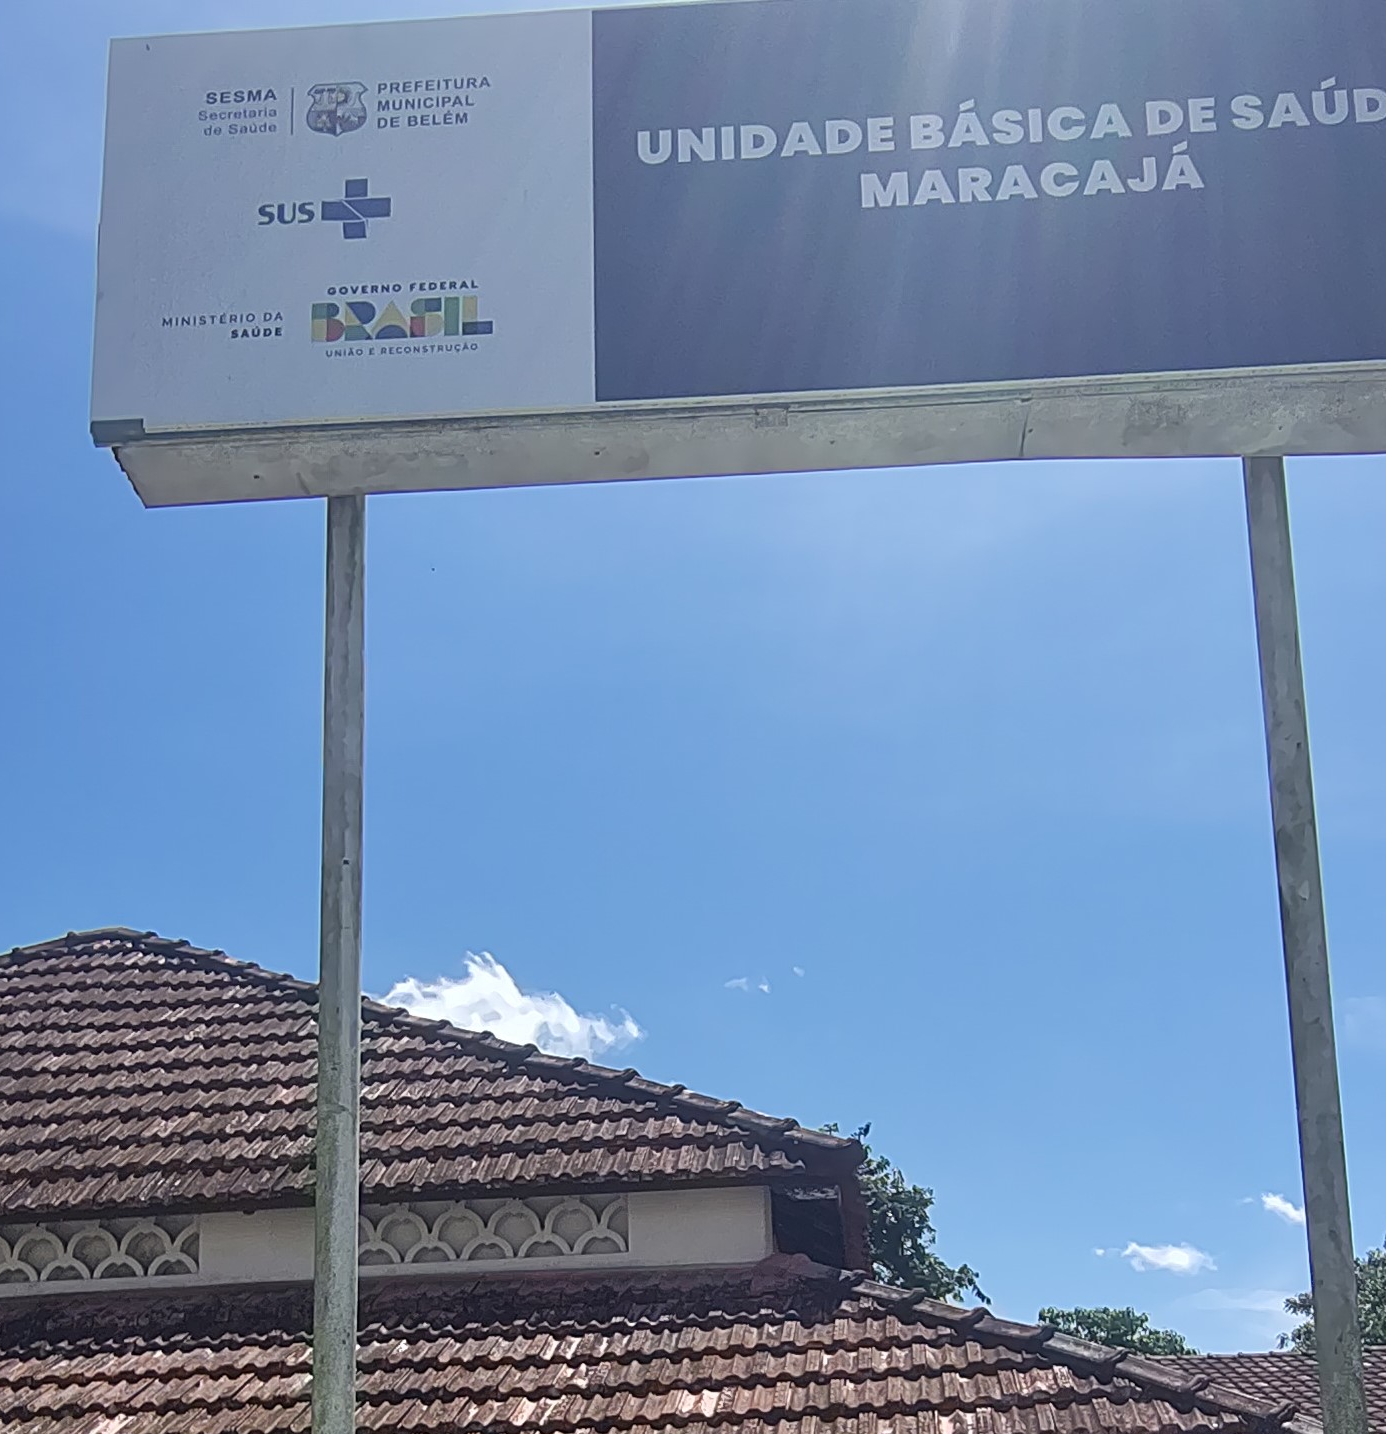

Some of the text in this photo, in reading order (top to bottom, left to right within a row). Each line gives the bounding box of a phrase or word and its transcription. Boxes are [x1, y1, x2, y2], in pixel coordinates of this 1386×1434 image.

[377, 76, 491, 94] PREFEITURA
[206, 88, 277, 105] SESMA
[377, 95, 475, 112] MUNICIPAL
[198, 107, 277, 122] Secretaria
[377, 110, 468, 129] DE BELÉM
[203, 122, 277, 136] de Saúde
[637, 117, 896, 164] UNIDADE
[910, 100, 1132, 149] BÁSICA
[1145, 97, 1217, 136] DE
[860, 140, 1204, 208] MARACAJÁ
[257, 202, 315, 225] SUS
[327, 280, 479, 296] GOVERNO FEDERAL
[162, 311, 283, 327] MINISTÉRIO DA
[311, 295, 493, 342] BRASIL
[231, 326, 283, 339] SAÚDE
[325, 347, 363, 358] UNIÃO
[380, 342, 478, 355] RECONSTRUÇÃO
